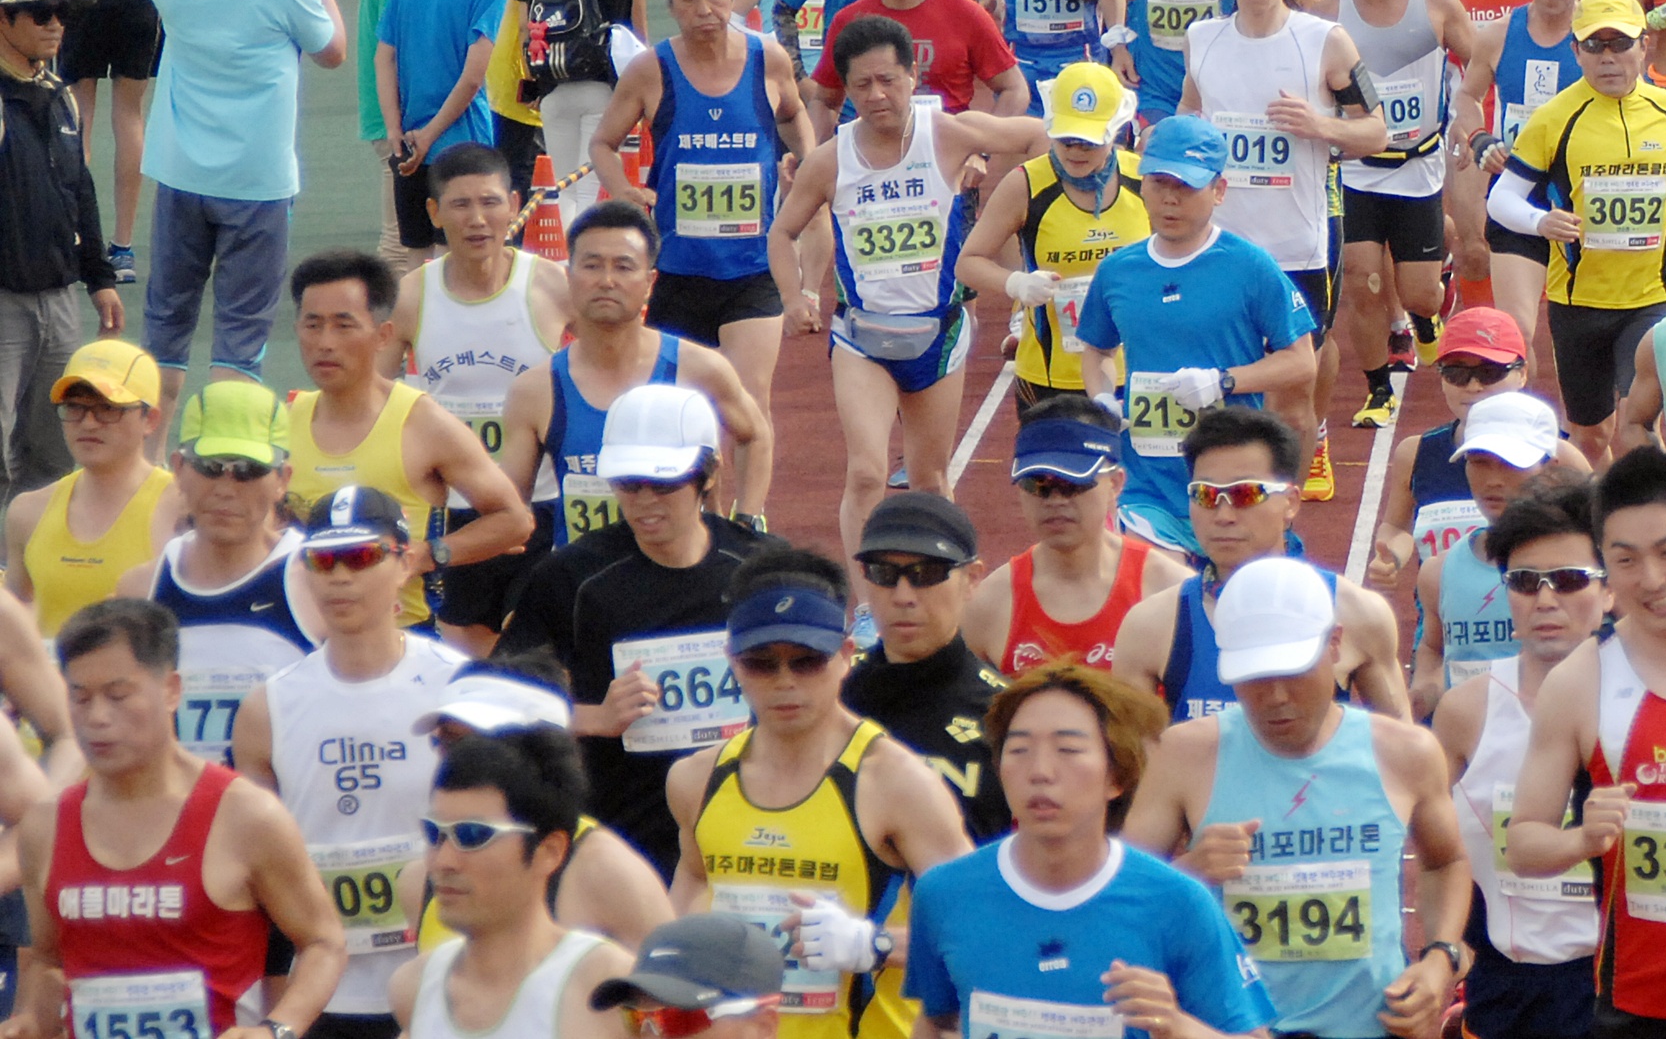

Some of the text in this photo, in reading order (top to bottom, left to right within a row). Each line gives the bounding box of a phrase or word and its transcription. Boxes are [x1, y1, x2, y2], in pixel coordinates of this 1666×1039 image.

[795, 6, 825, 30] 37
[1151, 4, 1215, 32] 2024
[1382, 95, 1421, 124] 08
[680, 182, 757, 214] 3115
[855, 176, 926, 206] 浜松市
[1588, 196, 1664, 225] 3052
[856, 219, 938, 259] 3323
[1132, 395, 1198, 429] 213
[569, 497, 622, 534] 31
[1443, 619, 1513, 645] 귀포마
[656, 665, 743, 713] 664
[186, 699, 240, 744] 77
[693, 728, 719, 740] duty
[318, 736, 408, 767] Clima
[334, 764, 383, 792] 65
[752, 827, 789, 847] Jeju
[57, 886, 183, 920] 애플마라톤
[332, 868, 400, 919] 09
[1563, 884, 1590, 897] duty
[1233, 897, 1365, 947] 3194
[82, 1007, 197, 1039] 1553
